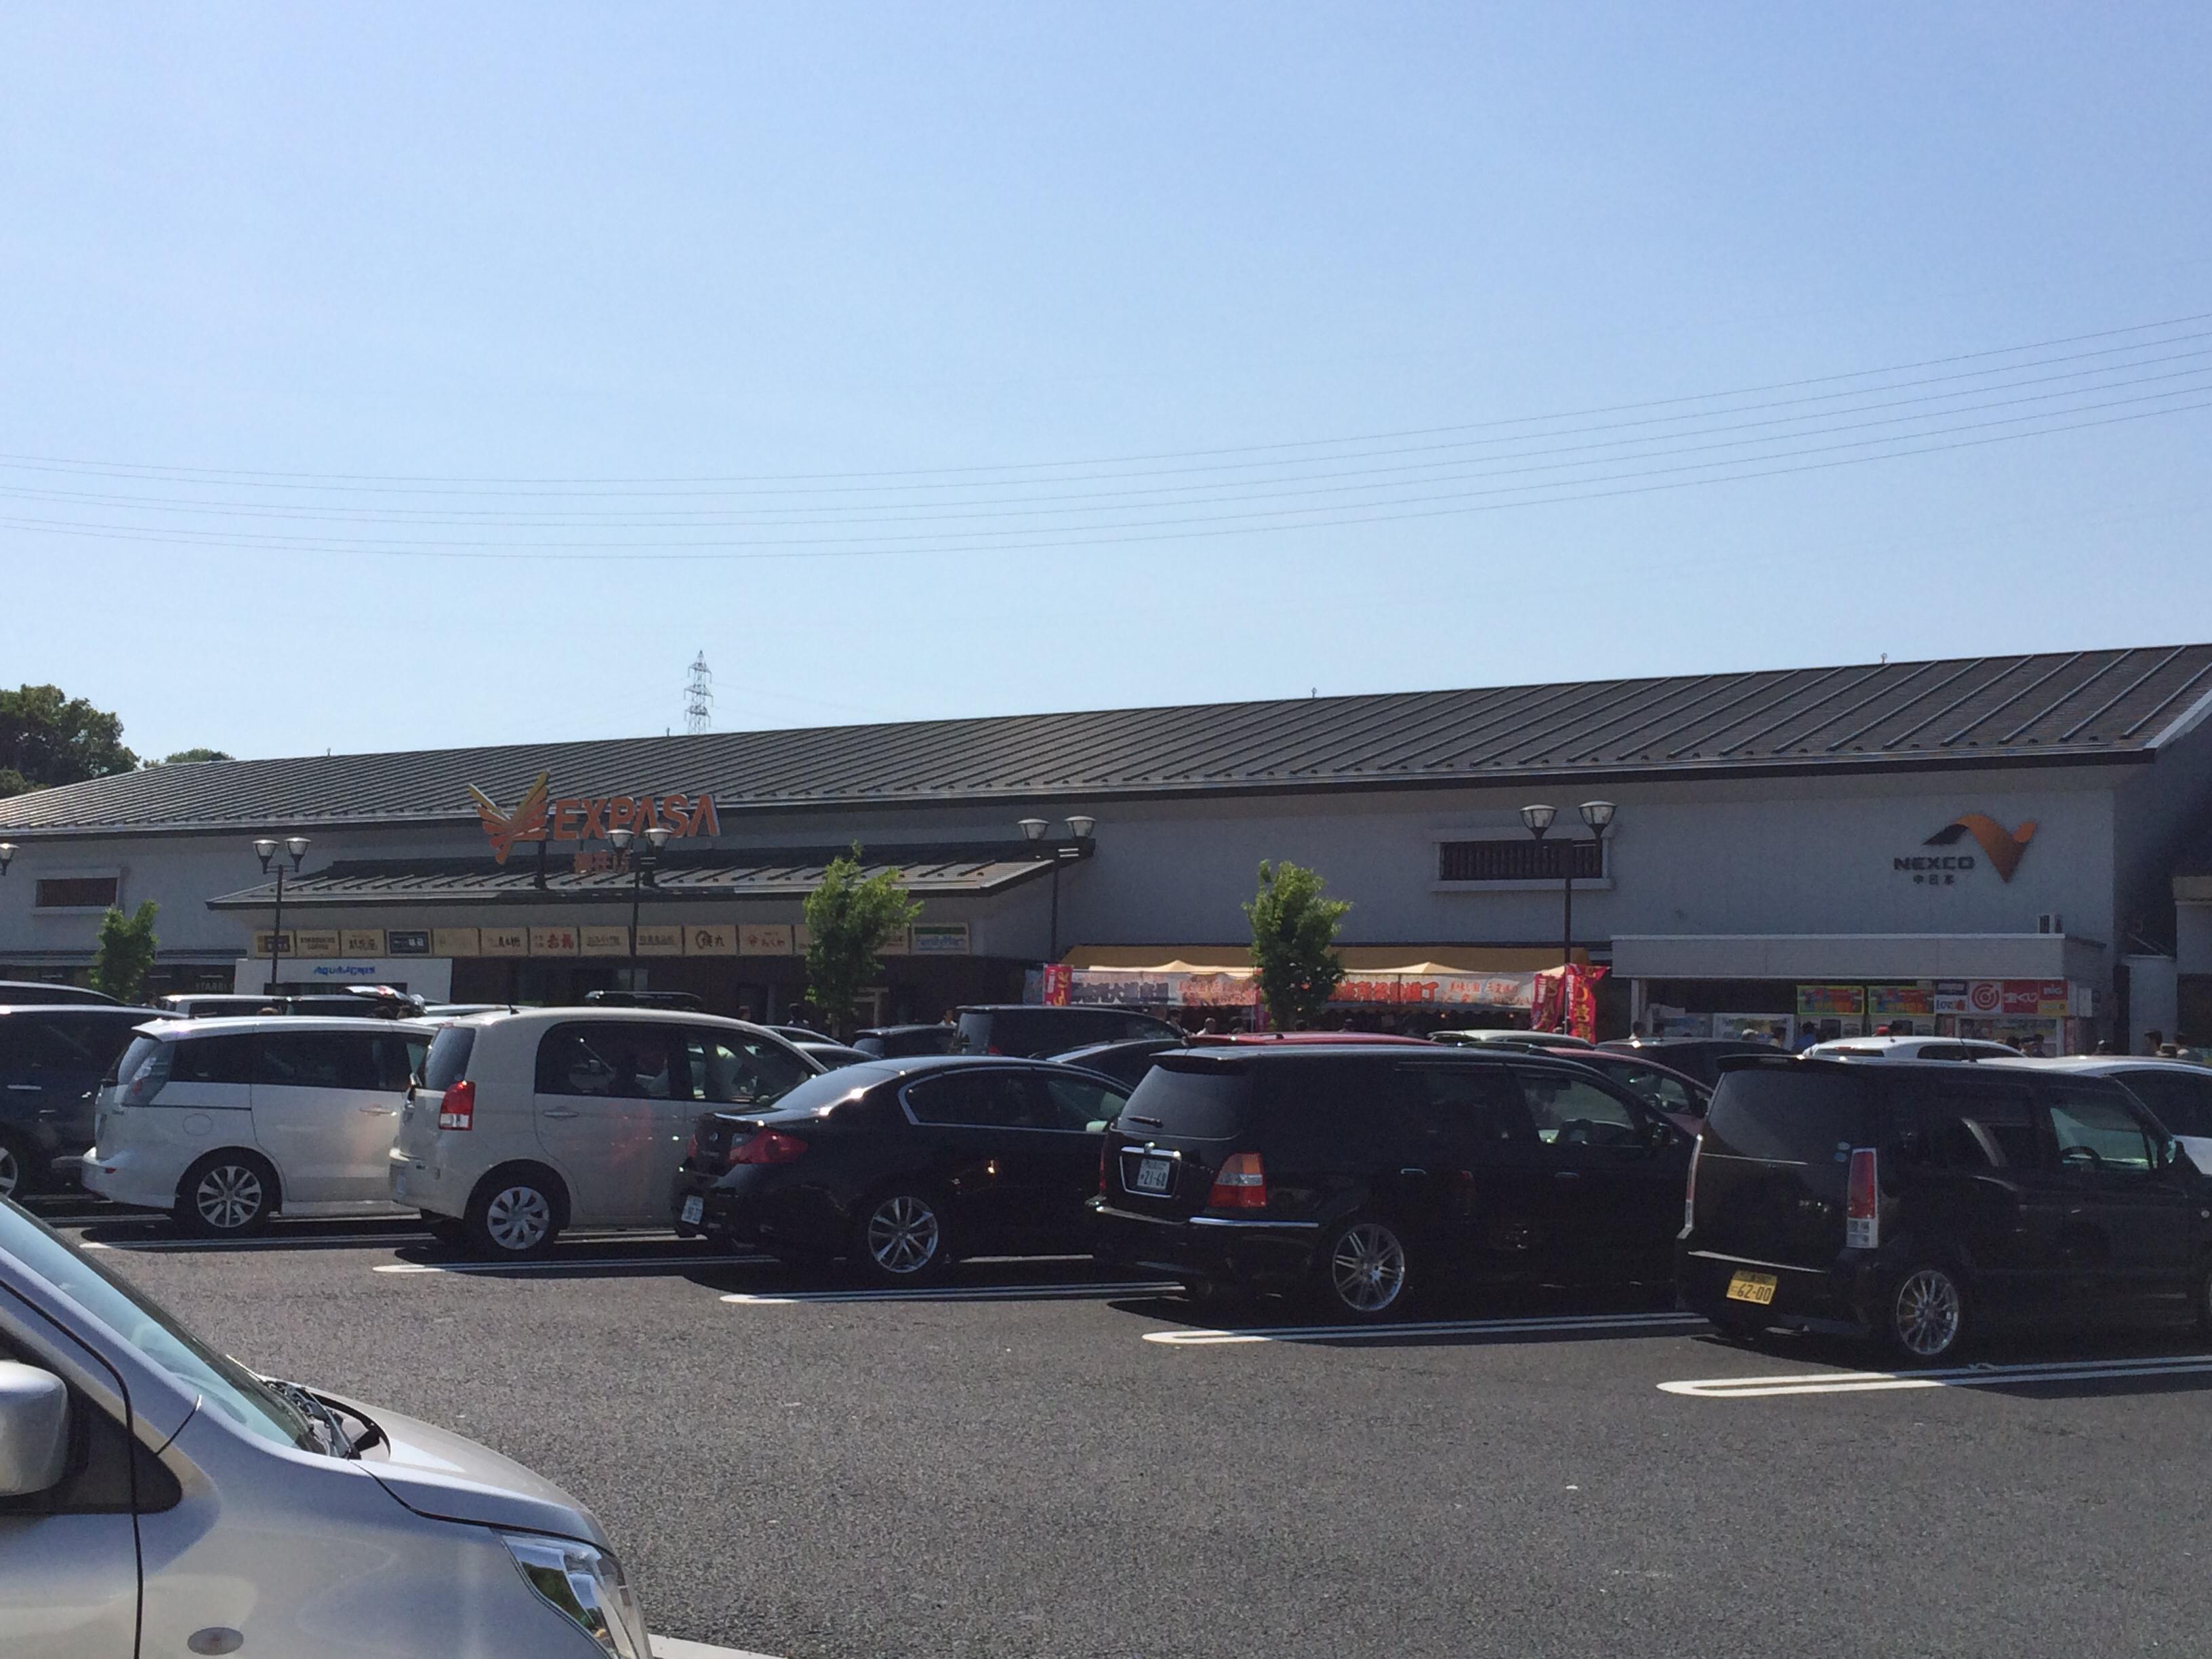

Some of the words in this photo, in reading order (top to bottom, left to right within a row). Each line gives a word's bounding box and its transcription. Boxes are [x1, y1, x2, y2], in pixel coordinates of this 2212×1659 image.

[554, 794, 720, 840] EXPASA
[1893, 857, 1975, 869] NEXCO
[1737, 1283, 1772, 1302] 62-00
